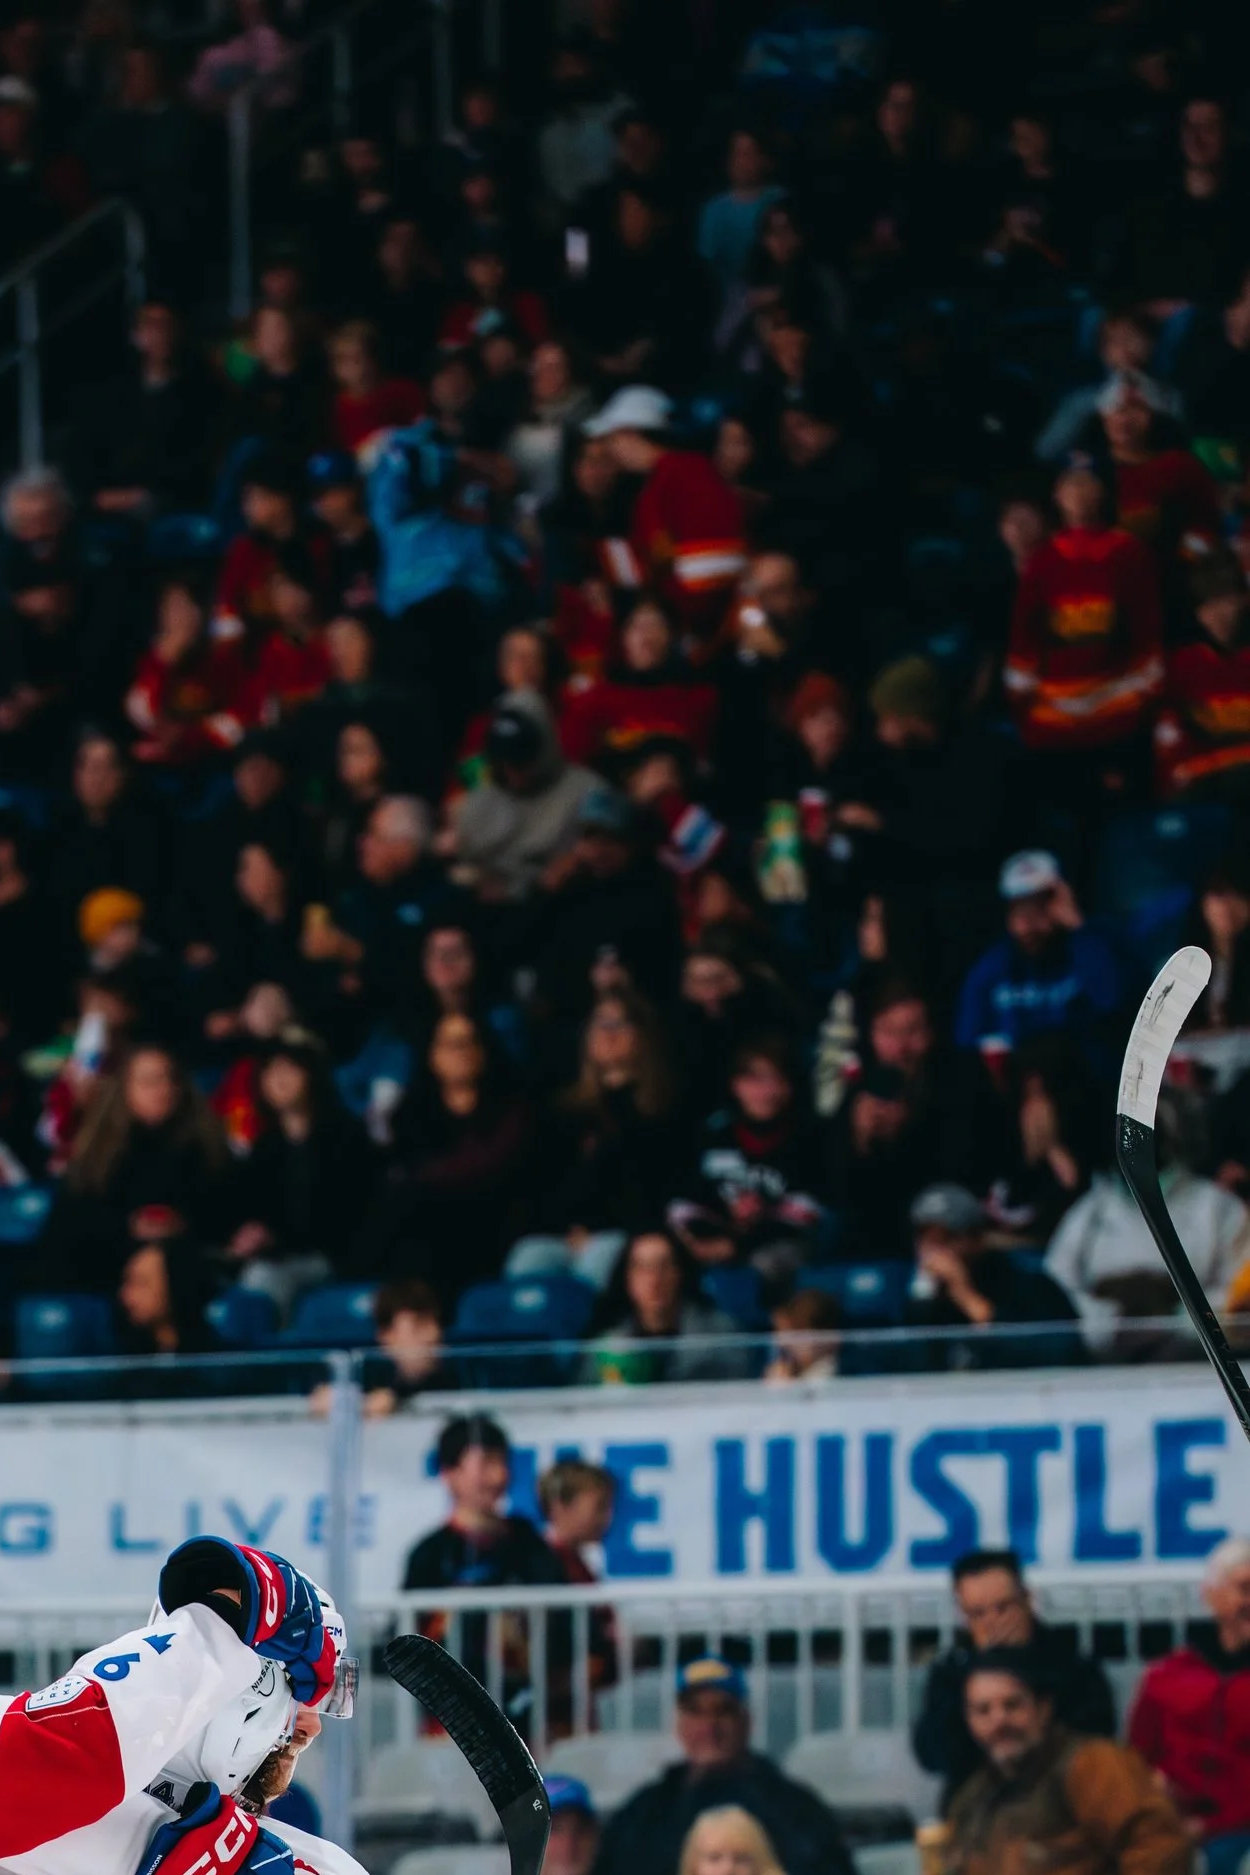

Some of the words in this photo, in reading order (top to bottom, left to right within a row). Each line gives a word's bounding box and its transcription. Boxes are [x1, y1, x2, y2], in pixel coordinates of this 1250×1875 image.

[713, 1417, 1229, 1574] HUSTLE
[109, 1496, 378, 1552] LIVE
[251, 1659, 273, 1692] NISSAN
[142, 1778, 176, 1810] 4
